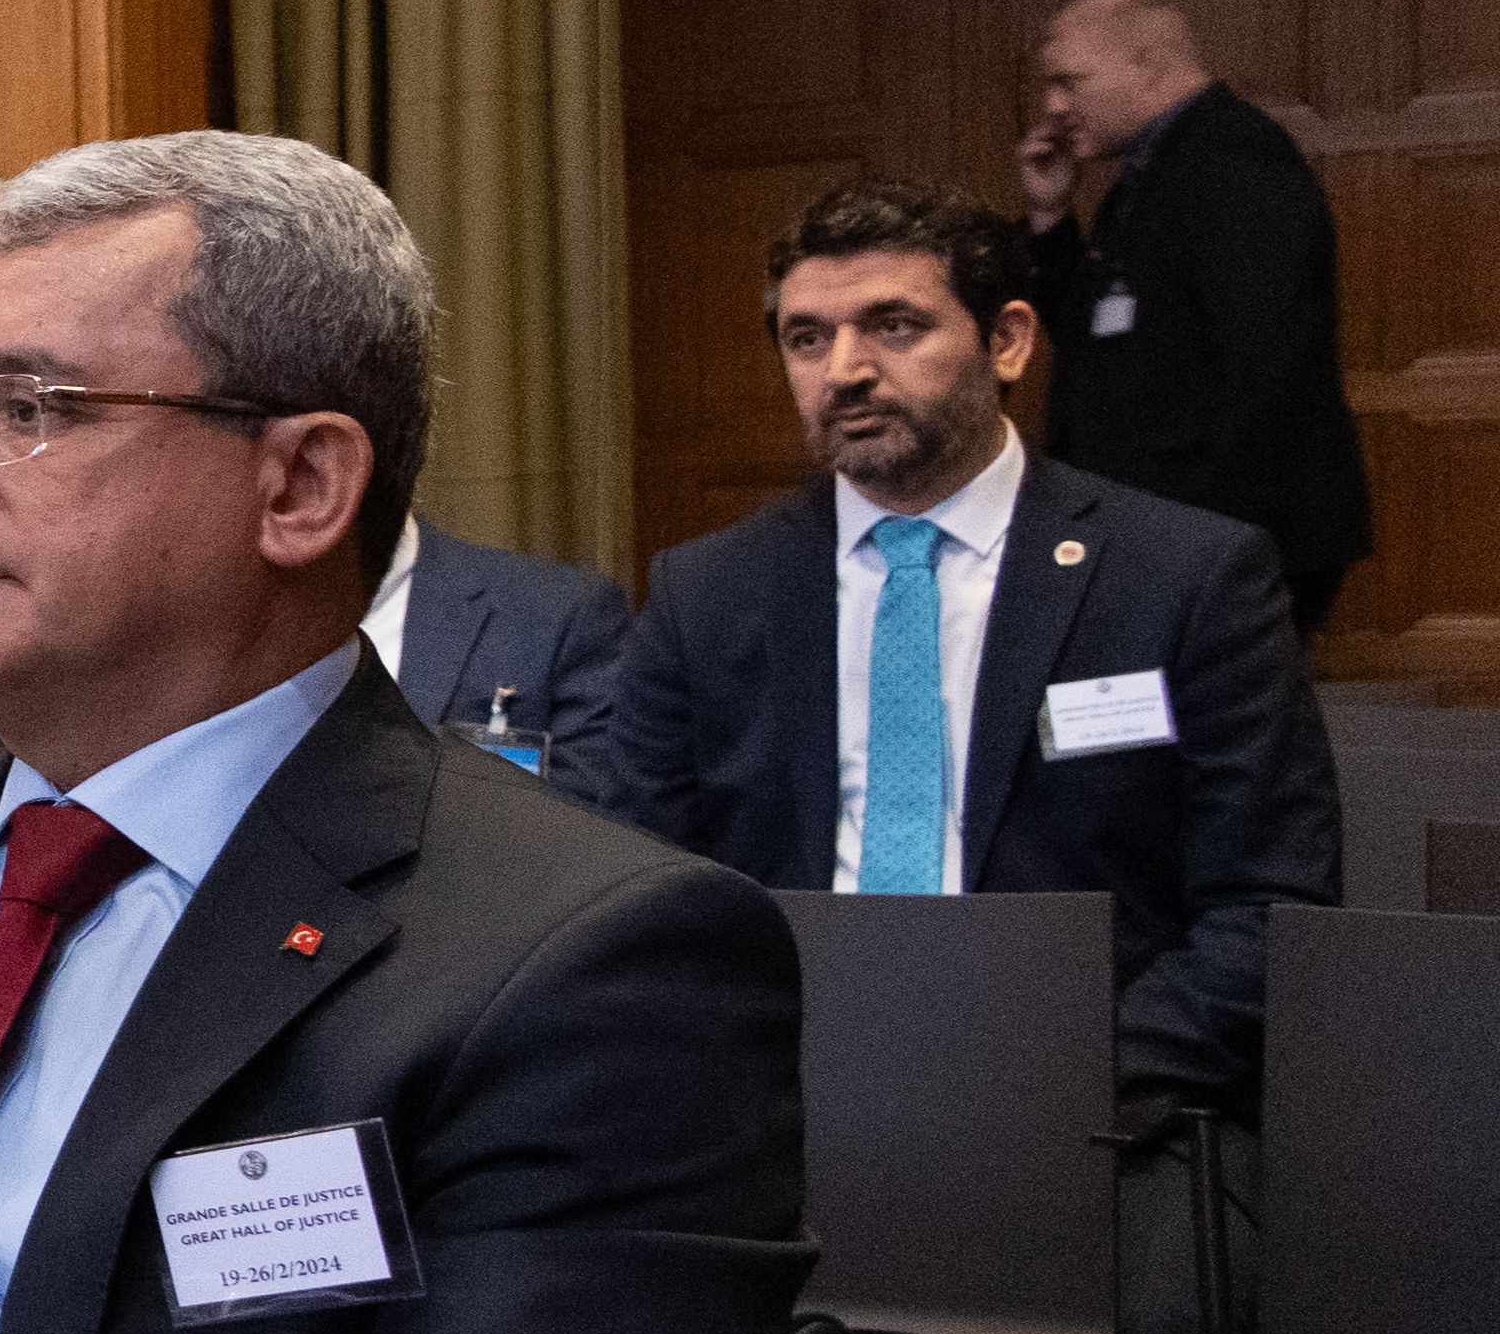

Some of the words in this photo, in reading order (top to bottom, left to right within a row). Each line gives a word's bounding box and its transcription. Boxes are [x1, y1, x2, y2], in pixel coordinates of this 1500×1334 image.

[166, 1206, 228, 1225] GRANDE
[231, 1198, 276, 1216] SALLE
[279, 1194, 300, 1209] DE
[303, 1184, 364, 1207] JUSTICE
[181, 1229, 227, 1246] GREAT
[232, 1220, 272, 1237] HALL
[275, 1218, 295, 1232] OF
[298, 1208, 360, 1232] JUSTICE
[219, 1254, 343, 1287] 19-26/2/2024
